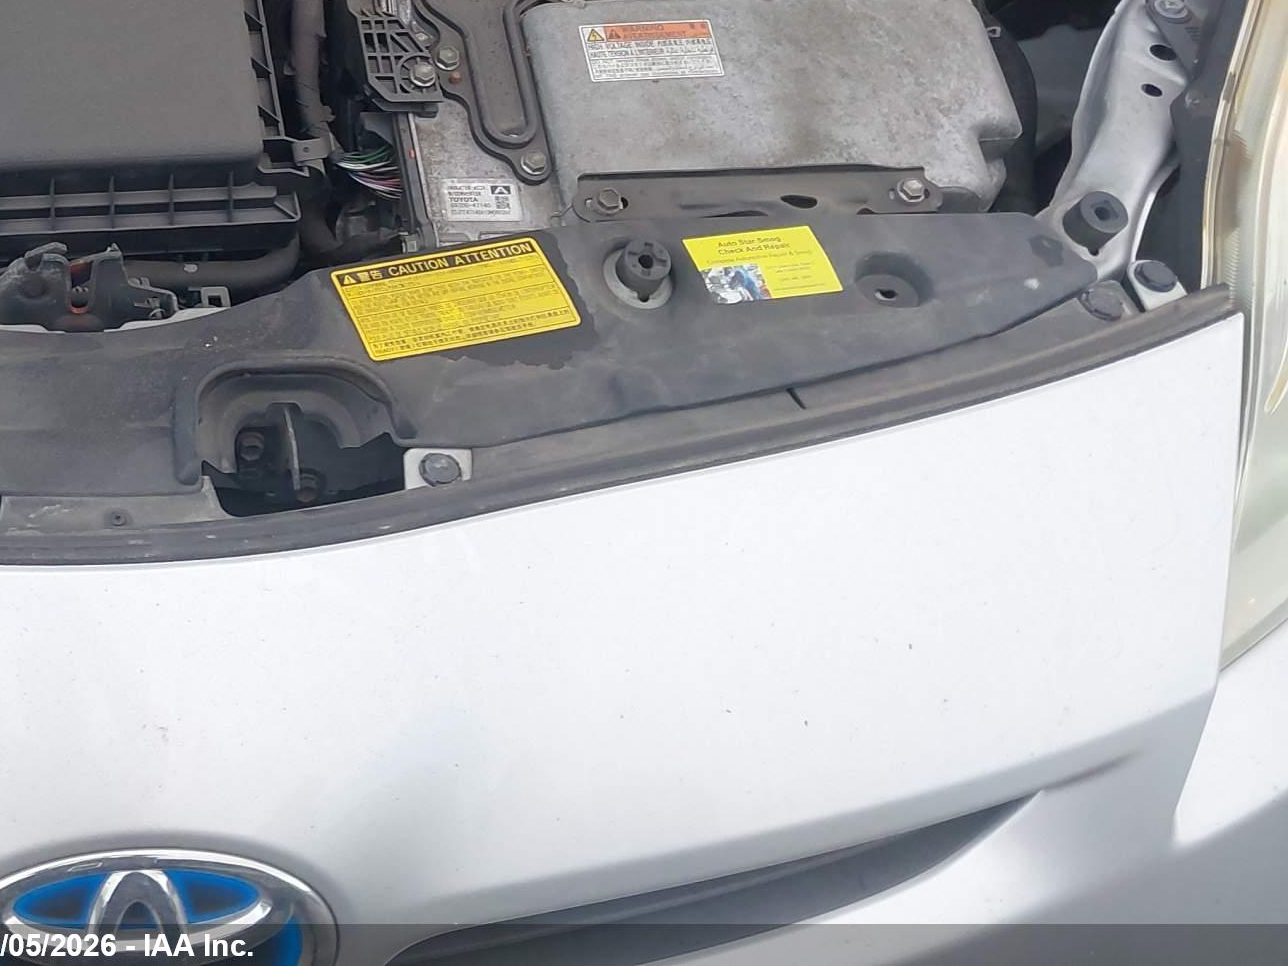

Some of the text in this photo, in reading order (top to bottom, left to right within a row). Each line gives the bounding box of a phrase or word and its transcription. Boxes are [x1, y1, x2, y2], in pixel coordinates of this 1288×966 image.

[388, 242, 533, 278] CAUTION ATTENTION
[718, 247, 744, 255] Check
[764, 243, 791, 251] Repair
